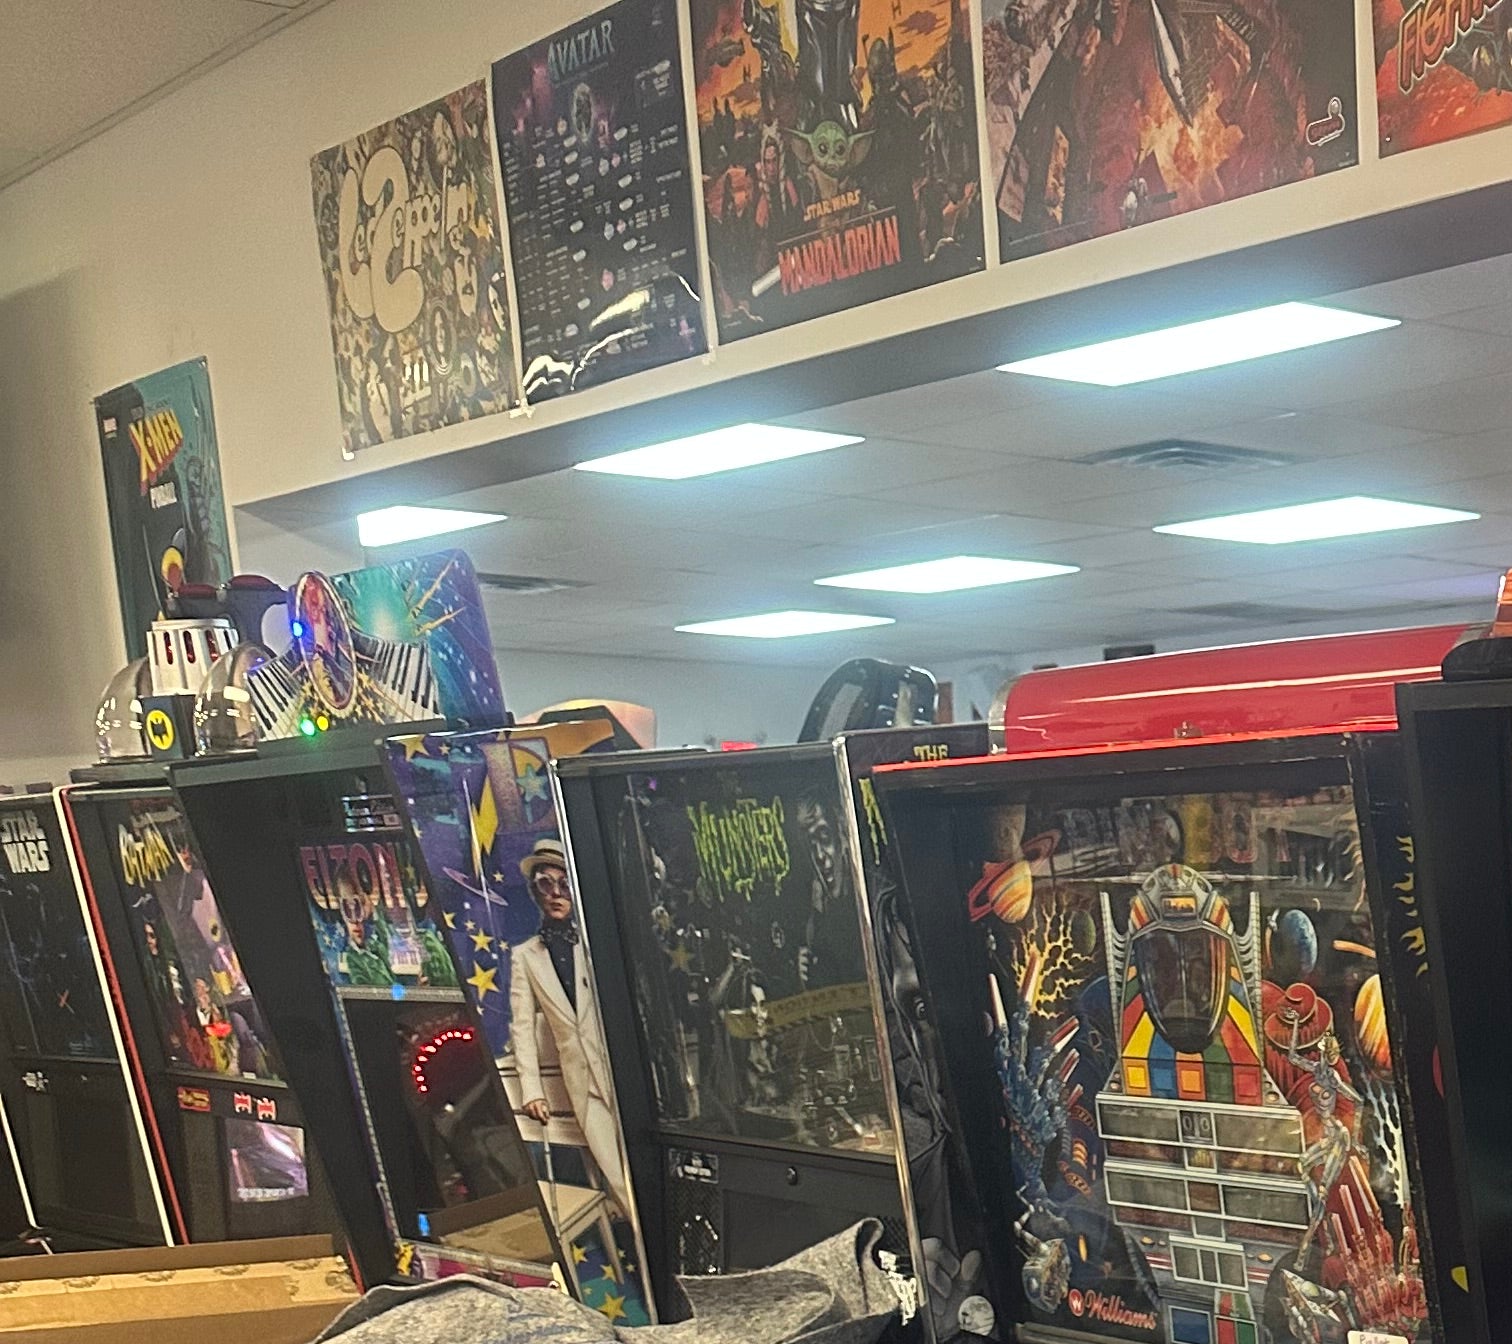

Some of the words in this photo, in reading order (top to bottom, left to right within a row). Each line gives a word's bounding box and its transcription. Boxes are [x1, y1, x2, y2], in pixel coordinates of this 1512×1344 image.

[549, 20, 615, 82] AVATAR
[778, 214, 902, 297] MANDALORIAN
[128, 407, 185, 486] X-MEN
[0, 810, 46, 842] STAR
[3, 838, 50, 874] WARS
[118, 812, 175, 888] BATMAN
[687, 796, 791, 903] MUNSTERS
[300, 842, 407, 909] ELTON
[1085, 1290, 1157, 1330] Williams
